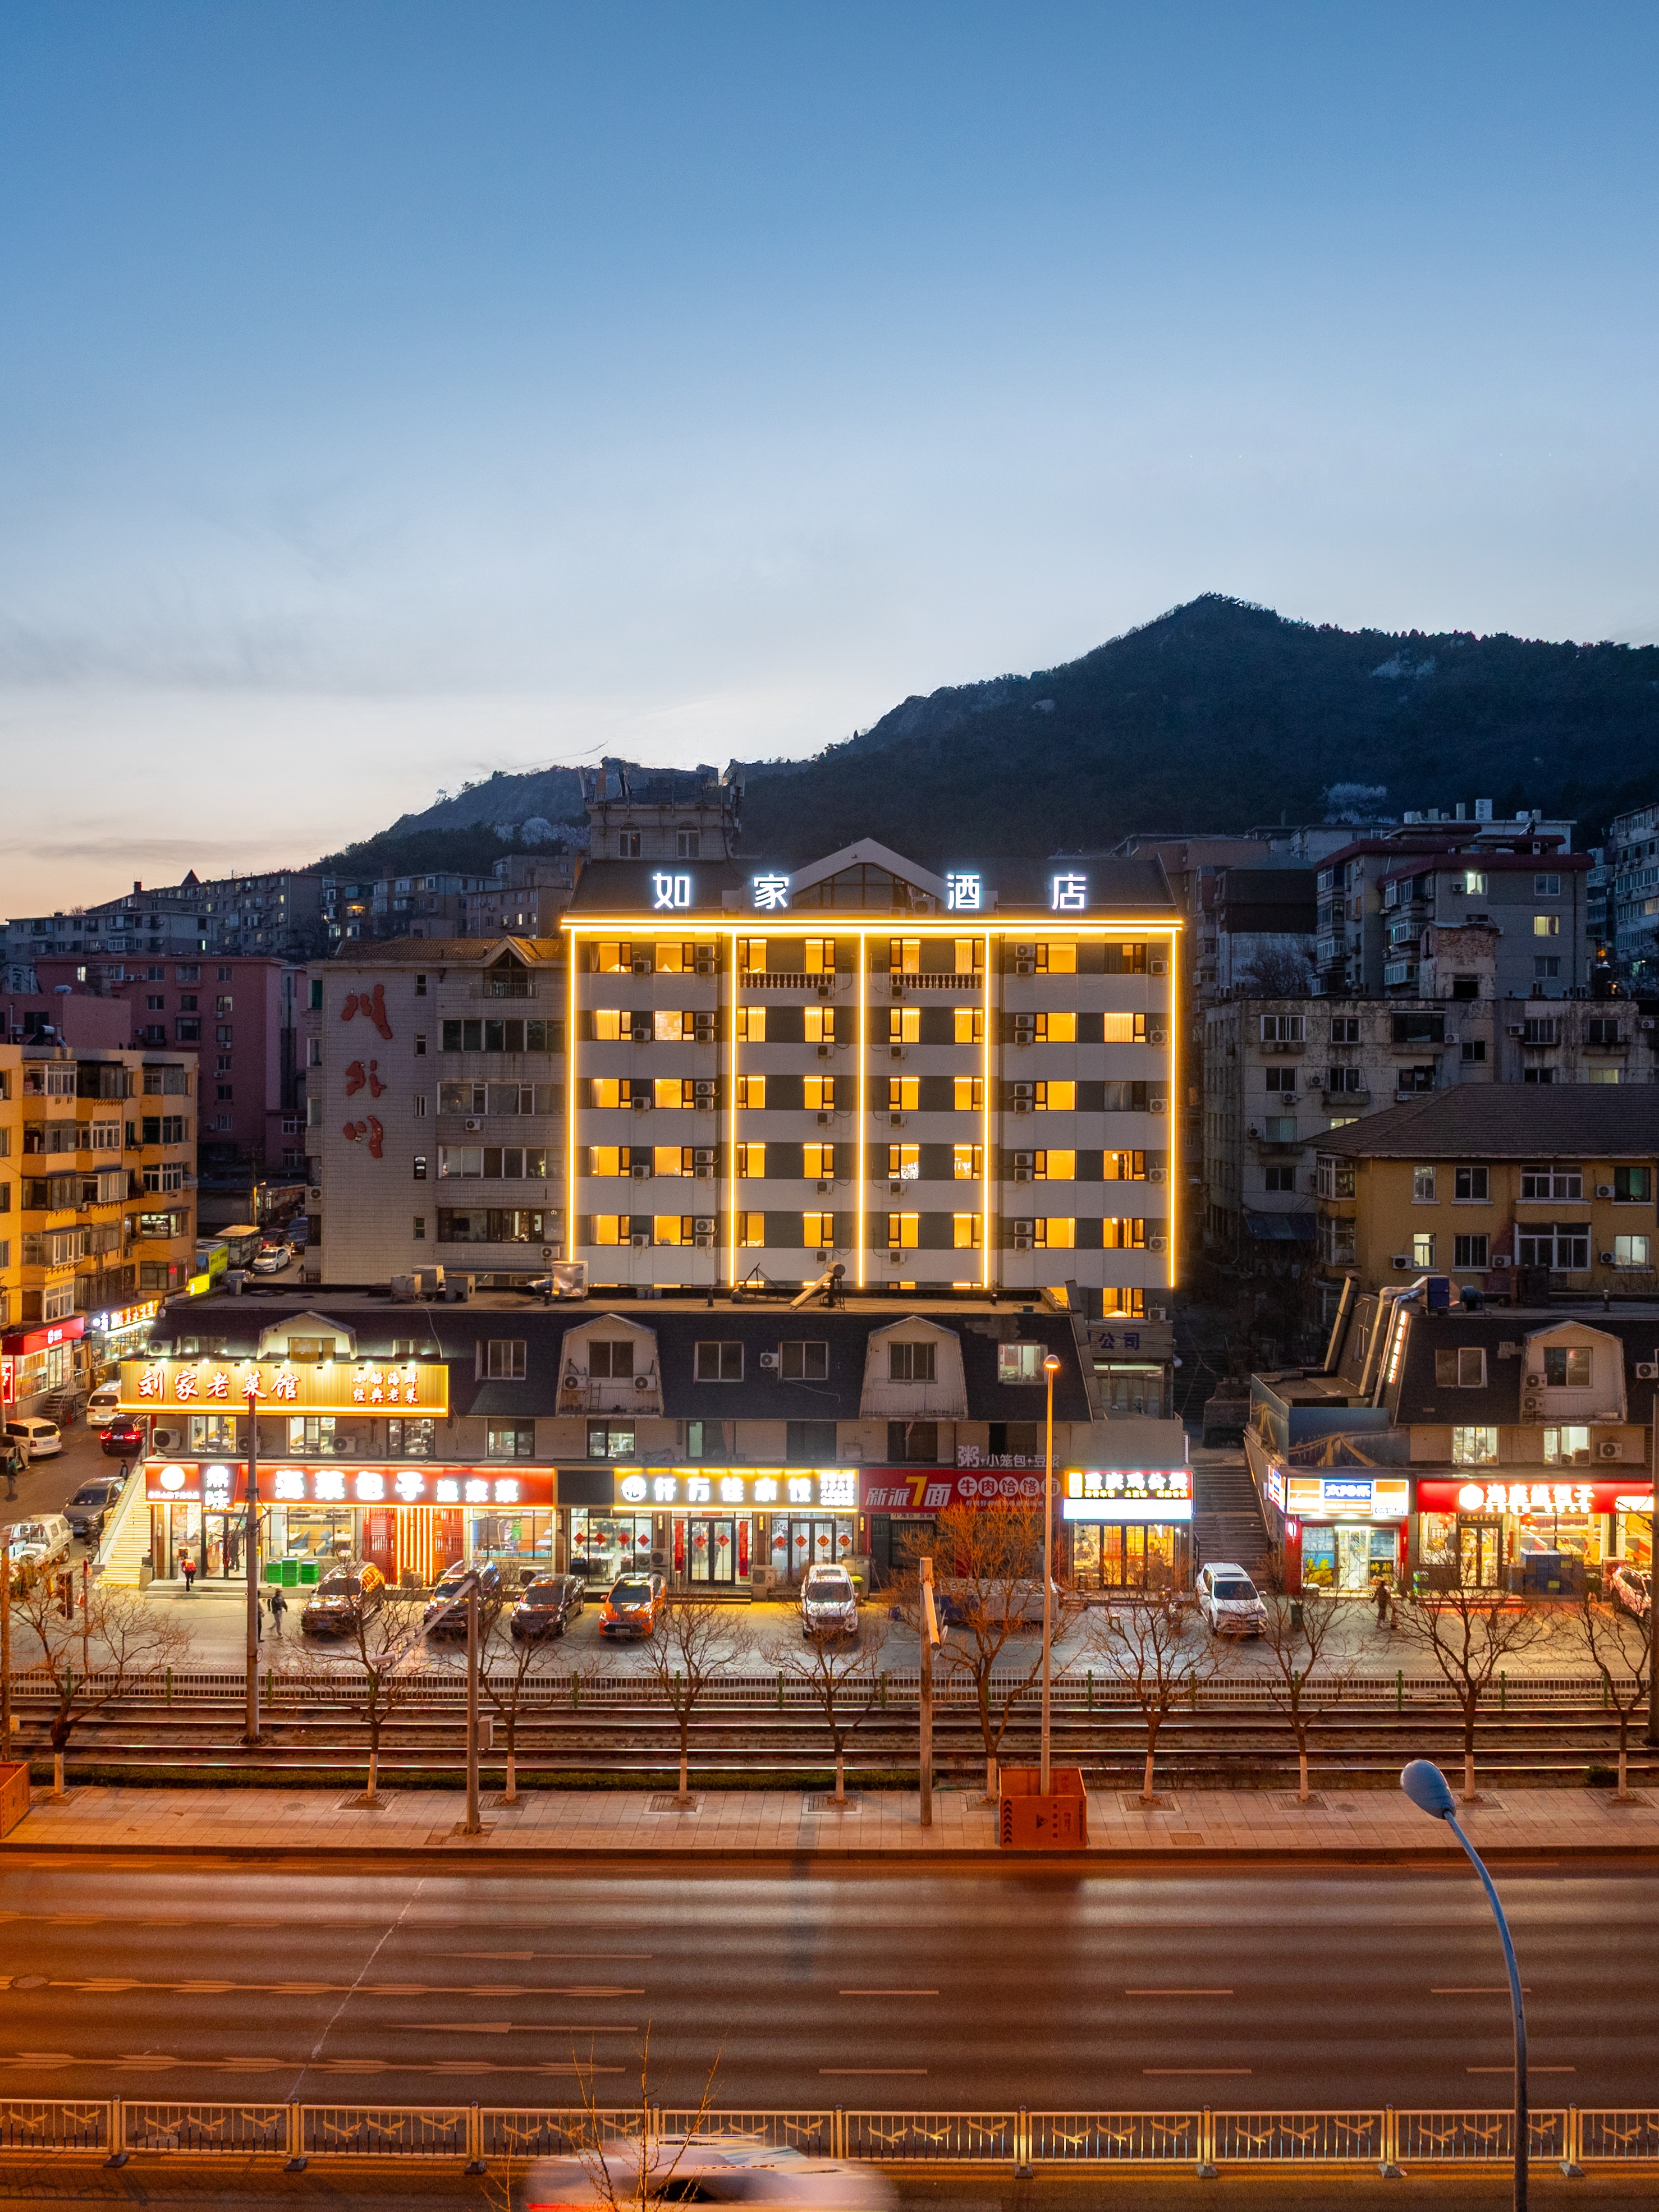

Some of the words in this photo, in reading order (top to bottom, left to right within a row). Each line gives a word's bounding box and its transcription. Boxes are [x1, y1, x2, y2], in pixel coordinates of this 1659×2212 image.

[653, 873, 1086, 910] 如家酒店
[1087, 1331, 1139, 1350] 公司
[139, 1369, 300, 1401] 刘家老菜馆
[353, 1387, 419, 1403] 经典老菜
[866, 1476, 952, 1507] 新派7面
